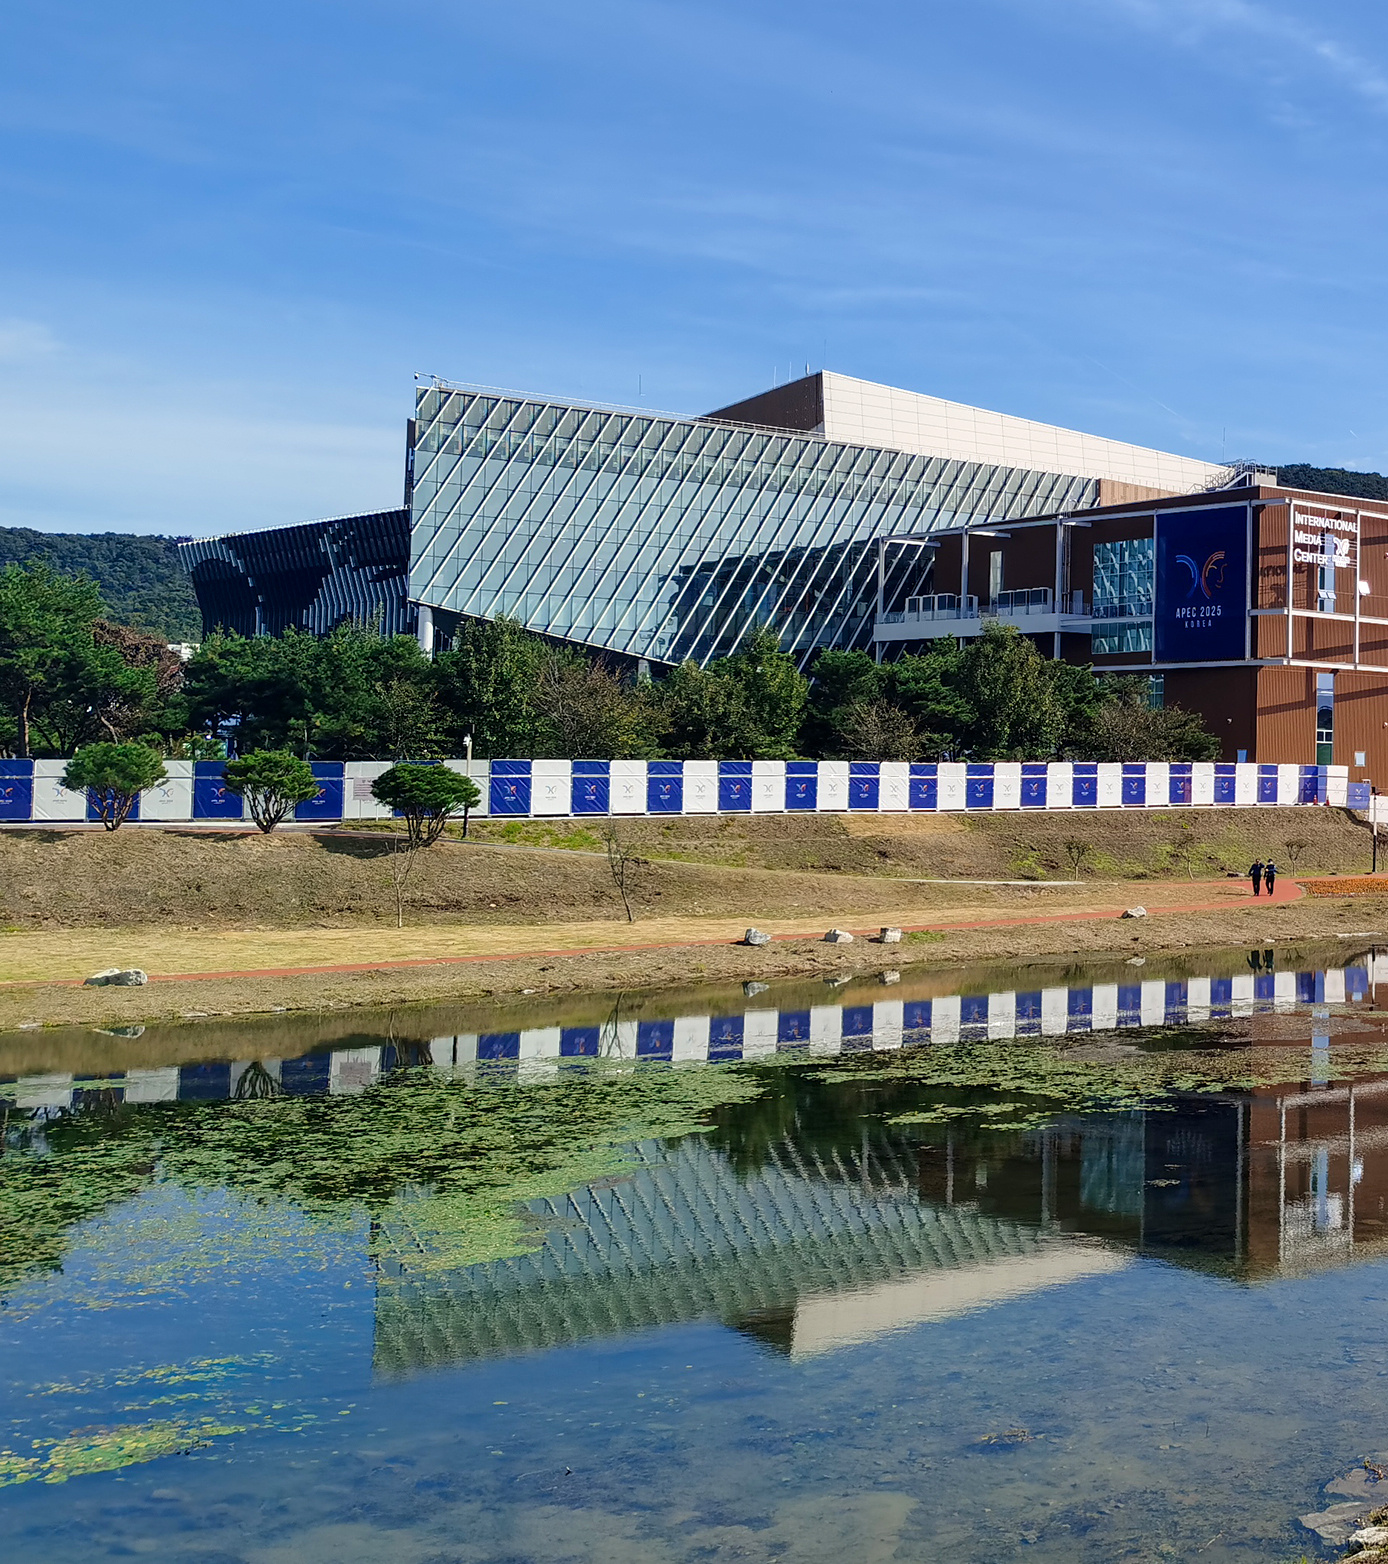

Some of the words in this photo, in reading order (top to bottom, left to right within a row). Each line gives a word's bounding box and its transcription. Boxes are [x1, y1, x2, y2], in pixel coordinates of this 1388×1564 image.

[1295, 511, 1358, 533] INTERNATIONAL
[1294, 530, 1322, 545] MEDIA
[1294, 548, 1328, 564] CENTER
[1175, 607, 1197, 618] APEC
[1200, 605, 1222, 617] 2025
[1184, 619, 1212, 628] KOREA
